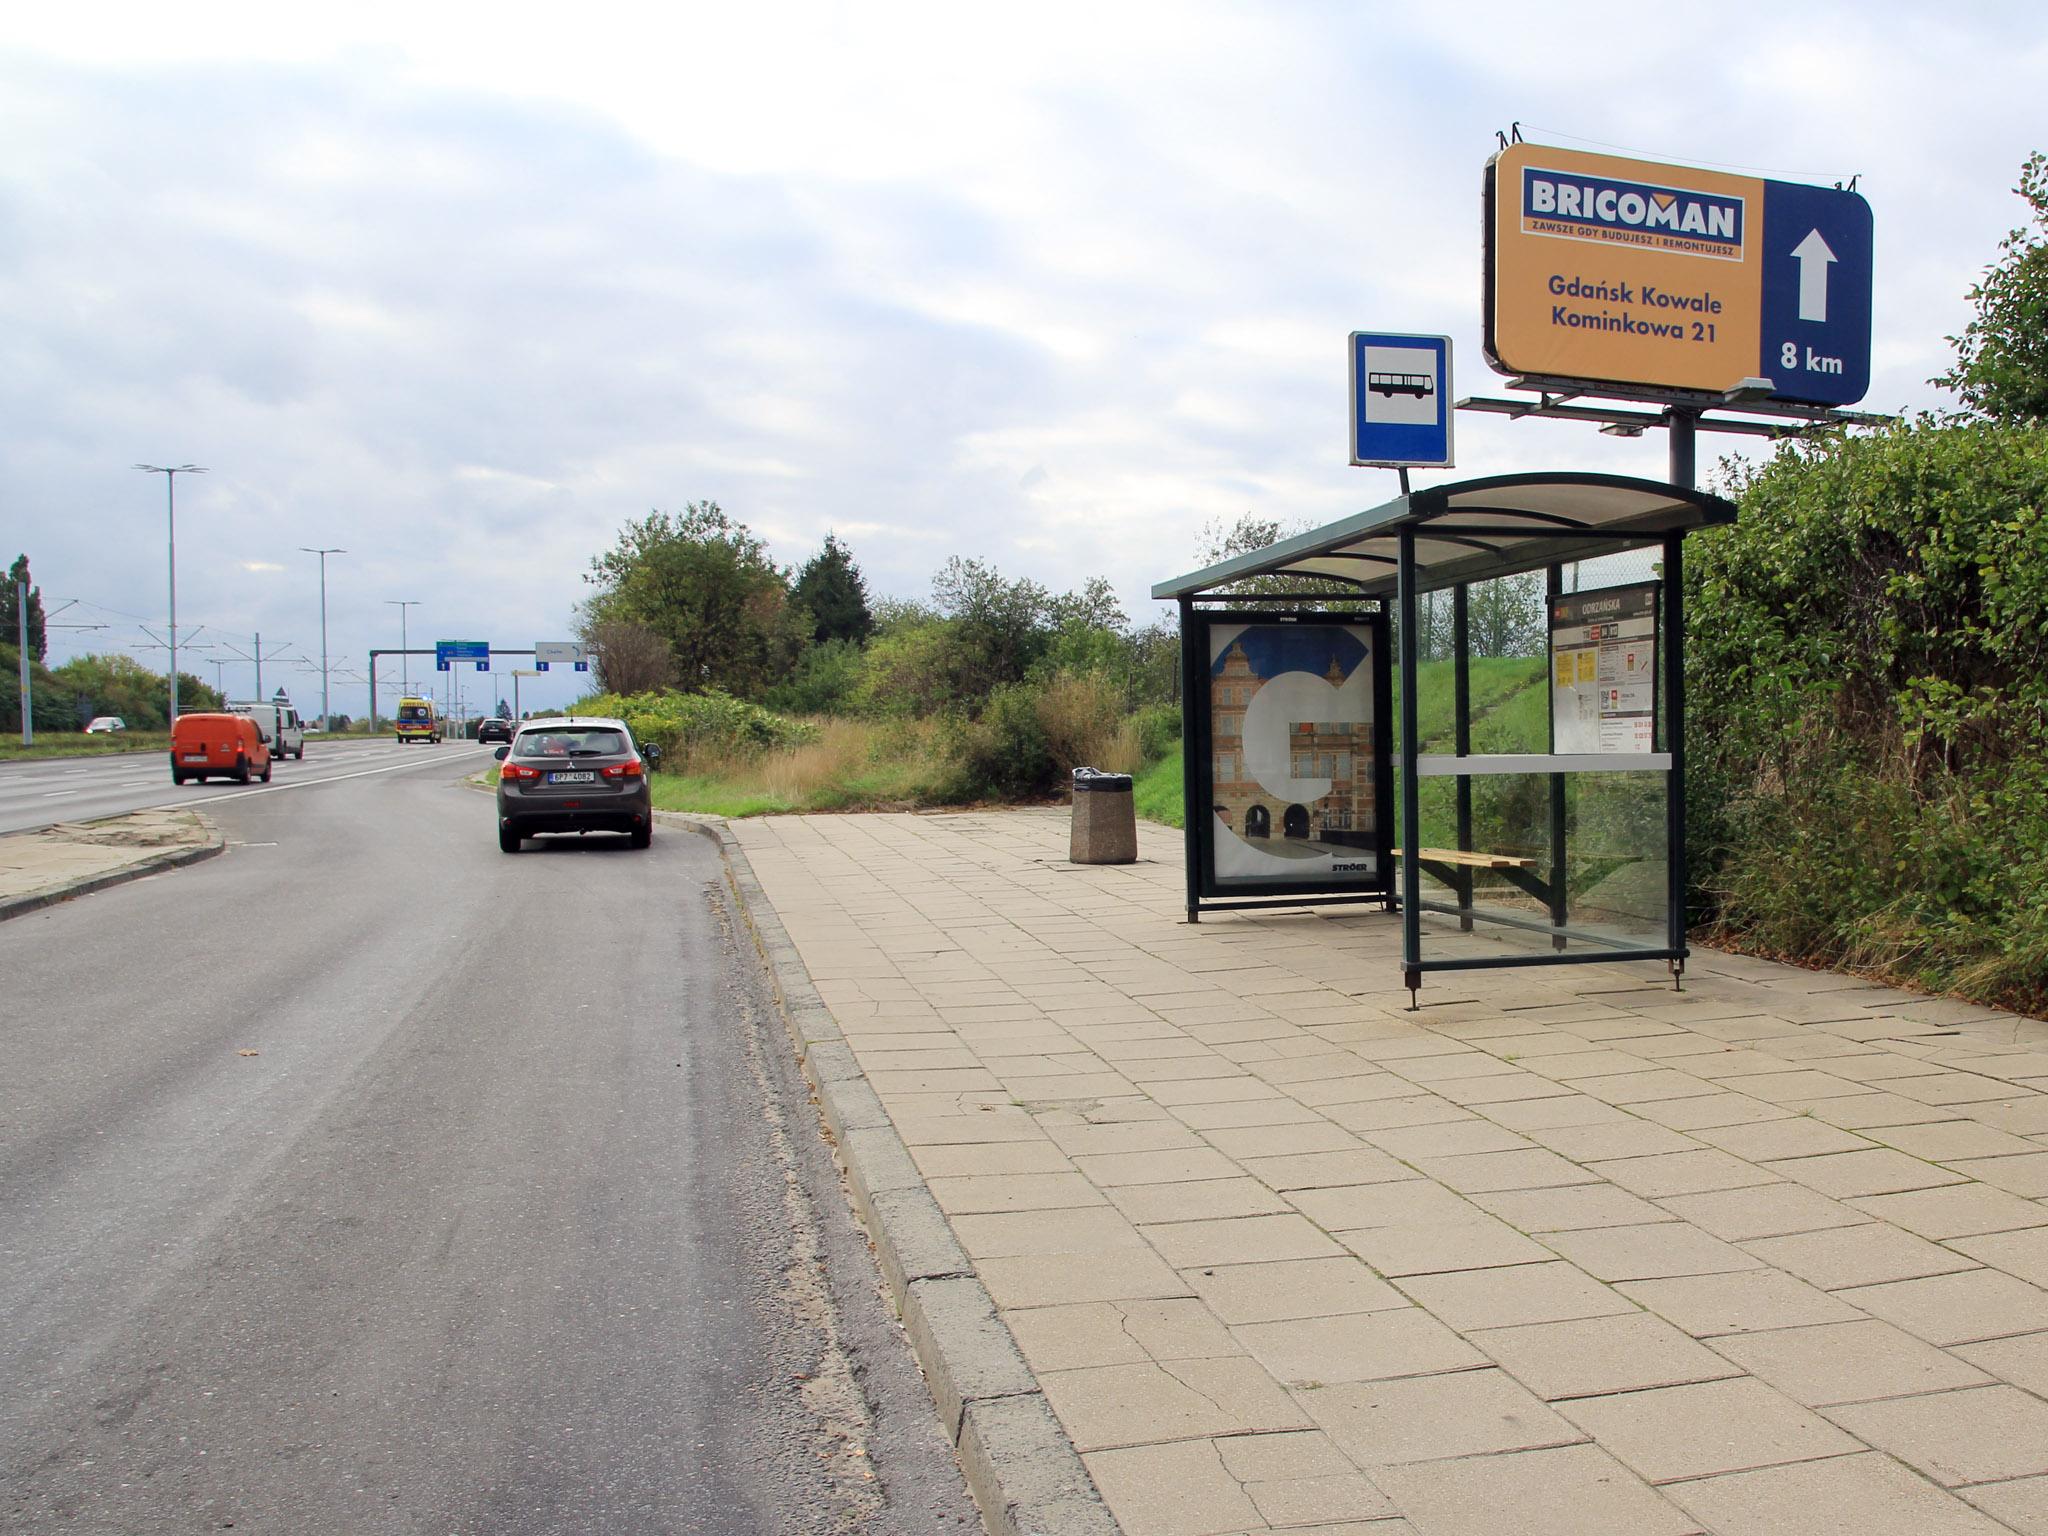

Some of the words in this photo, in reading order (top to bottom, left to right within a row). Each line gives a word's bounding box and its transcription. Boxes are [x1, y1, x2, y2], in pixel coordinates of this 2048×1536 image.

[1531, 179, 1735, 238] BRICOMAN
[1532, 220, 1574, 234] ZAWSZE
[1577, 227, 1598, 238] GDY
[1601, 230, 1653, 245] BUDUJESZ
[1663, 238, 1734, 256] REMONTUJESZ
[1548, 273, 1633, 304] Gdańsk
[1642, 286, 1722, 315] Kowale
[1551, 305, 1685, 341] Kominkowa
[1691, 322, 1716, 343] 21
[1780, 341, 1798, 369] 8
[1807, 347, 1843, 375] km
[573, 772, 591, 781] 4082
[1332, 862, 1368, 872] STRÖER
